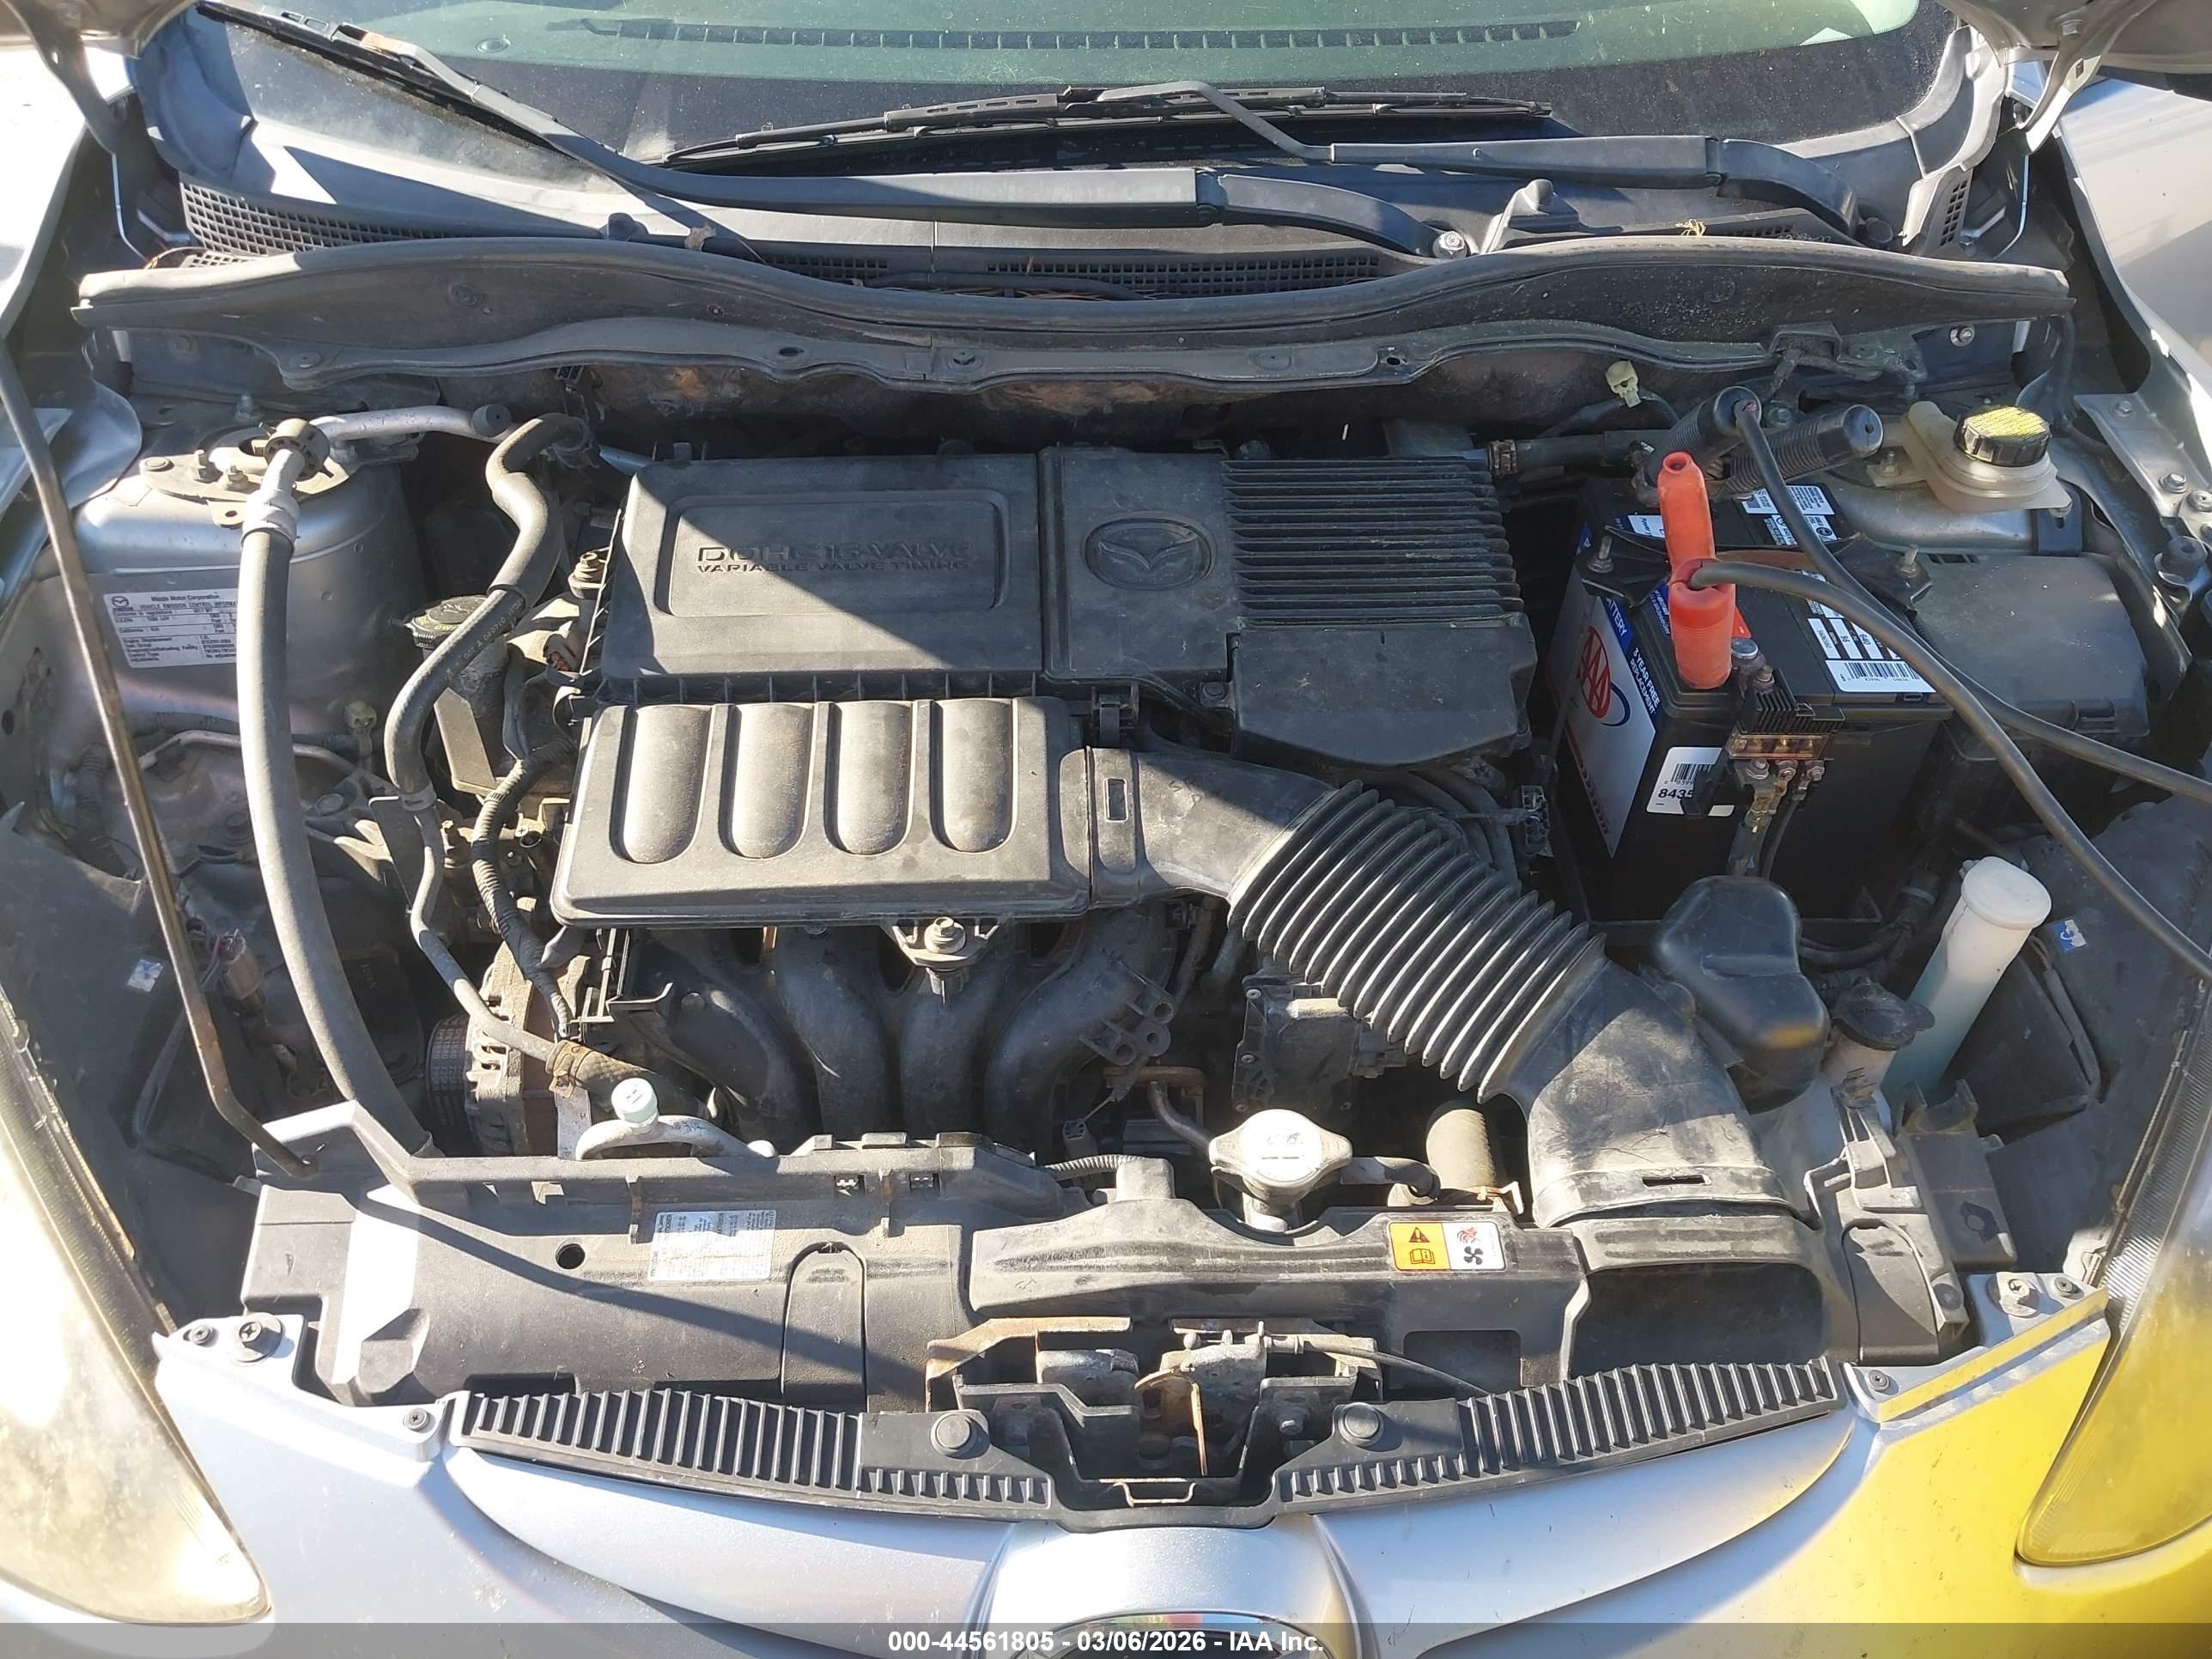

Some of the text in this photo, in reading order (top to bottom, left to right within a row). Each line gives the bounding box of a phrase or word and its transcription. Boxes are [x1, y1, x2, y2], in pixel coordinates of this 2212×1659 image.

[697, 560, 971, 573] VARIABLE VALVE TIMING
[1607, 598, 1628, 636] ATTERY
[1860, 634, 1872, 646] 640
[1633, 647, 1661, 708] 3 YEAR FREE
